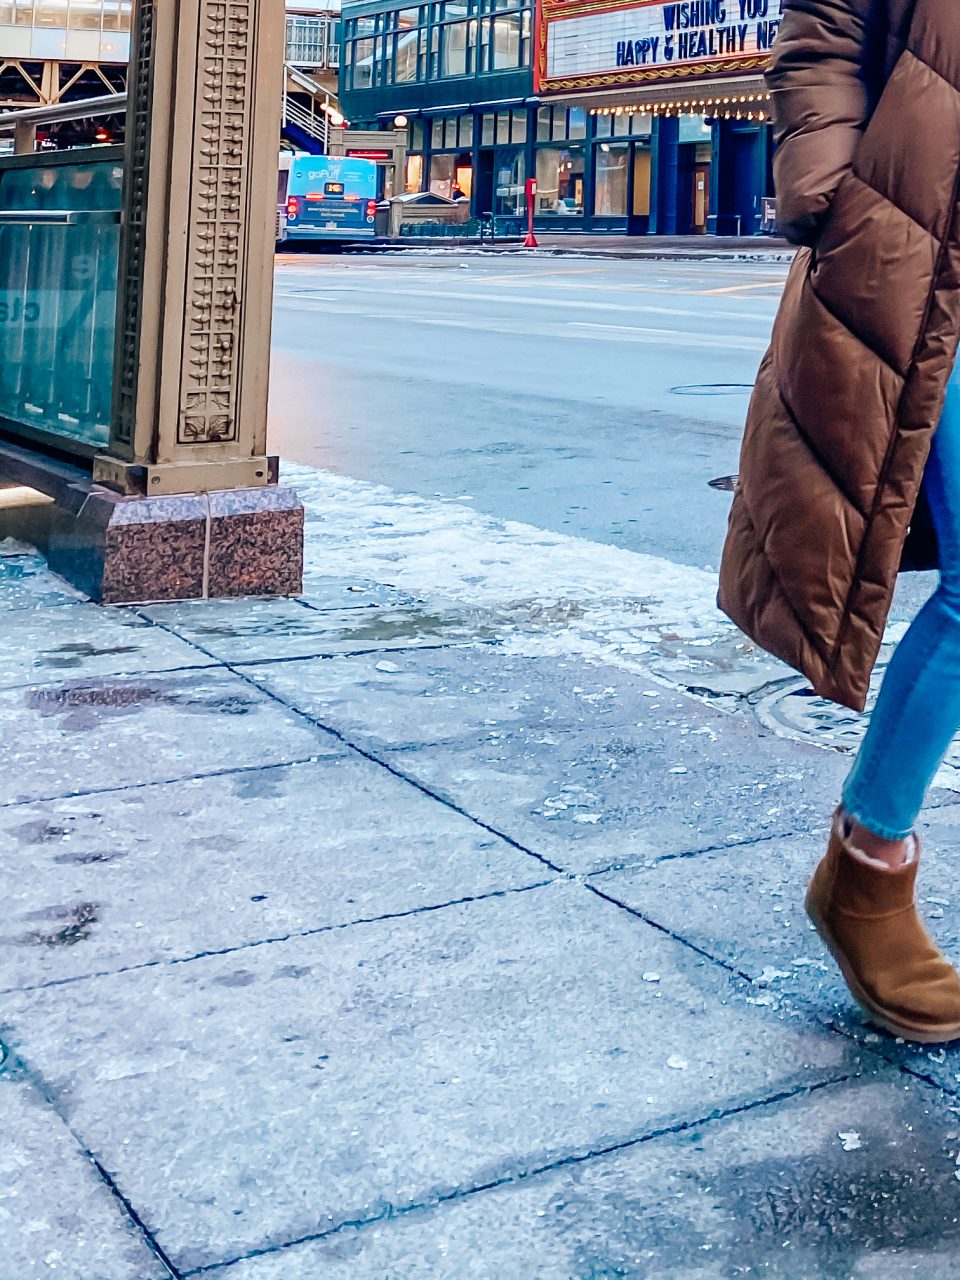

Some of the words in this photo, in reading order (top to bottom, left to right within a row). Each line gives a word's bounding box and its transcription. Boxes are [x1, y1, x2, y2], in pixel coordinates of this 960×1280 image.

[616, 36, 660, 67] HAPPY
[664, 34, 674, 62] &
[678, 23, 748, 60] HEALTHY
[756, 19, 782, 51] NE
